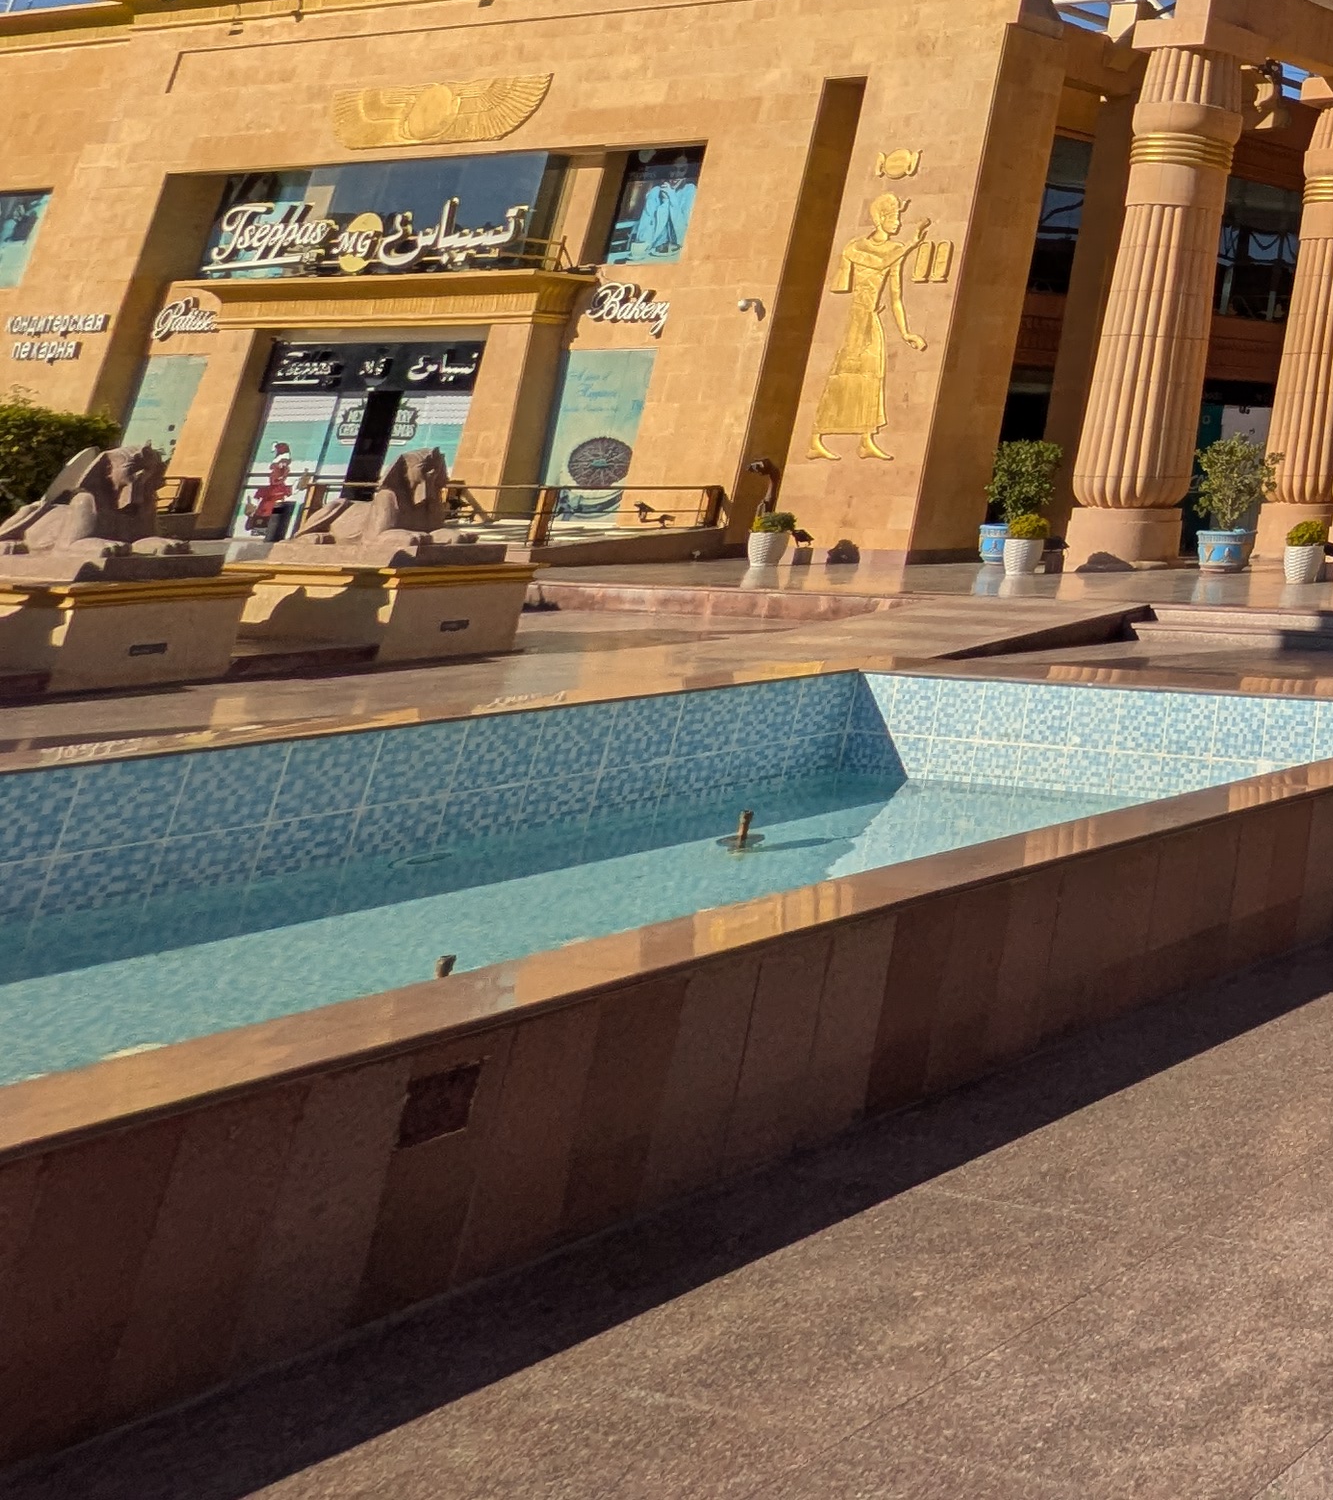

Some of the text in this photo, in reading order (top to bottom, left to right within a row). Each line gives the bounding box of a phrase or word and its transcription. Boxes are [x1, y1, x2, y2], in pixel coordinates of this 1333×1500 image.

[208, 202, 373, 265] Tseppas MG
[586, 282, 670, 336] Bakery
